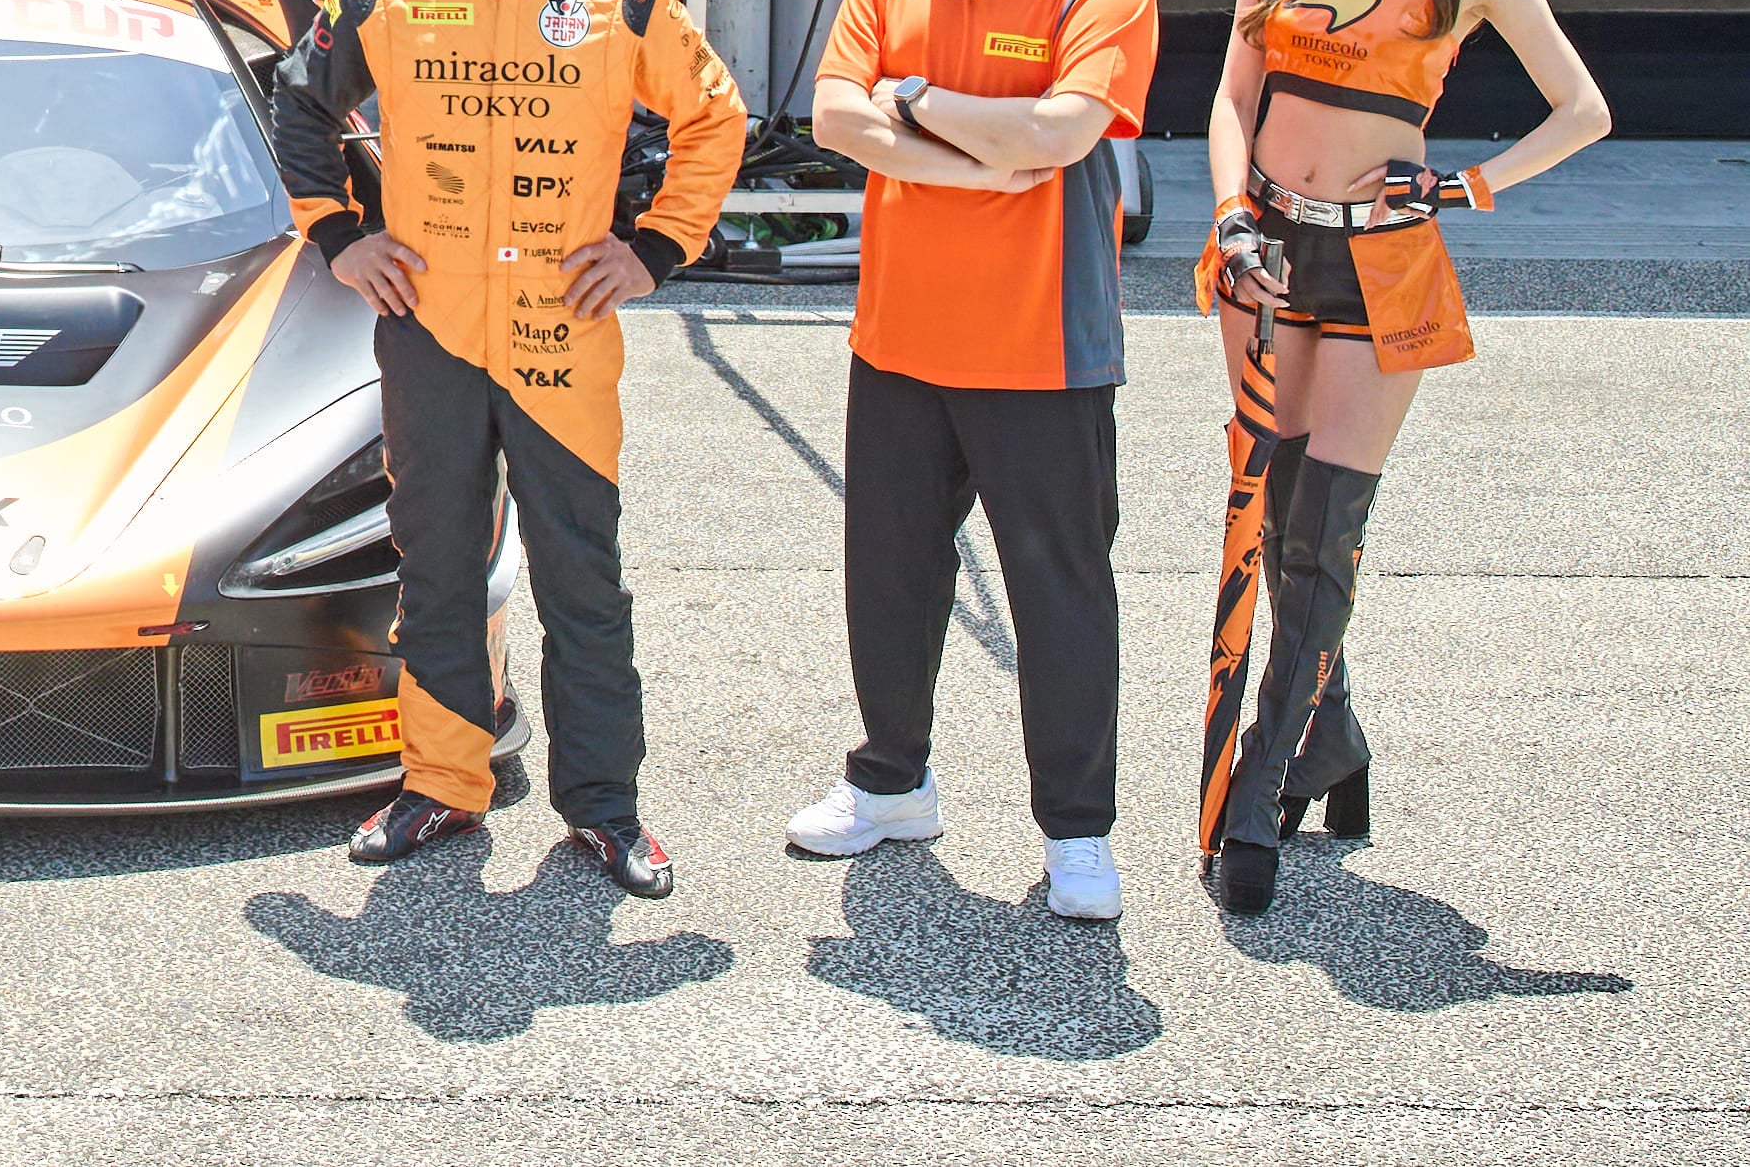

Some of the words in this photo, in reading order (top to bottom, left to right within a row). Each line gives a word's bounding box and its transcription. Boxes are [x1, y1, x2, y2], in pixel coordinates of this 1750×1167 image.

[411, 5, 468, 21] PIRELLI
[544, 15, 586, 30] JAPAN
[551, 29, 576, 42] CUP
[1291, 33, 1368, 59] miracolo
[989, 37, 1047, 58] PIRELLI
[413, 51, 582, 85] miracolo
[1305, 53, 1352, 71] TOKYO
[441, 94, 550, 118] TOKYO
[426, 142, 476, 153] UEMATSU
[515, 136, 579, 155] VALX
[513, 175, 574, 198] BPX
[511, 319, 552, 345] Map
[1380, 320, 1441, 345] miracolo
[513, 340, 574, 355] FINANCIAL
[1395, 337, 1434, 353] TOKYO
[513, 367, 573, 388] Y&K
[284, 663, 387, 703] Verity
[276, 708, 400, 755] PIRELLI
